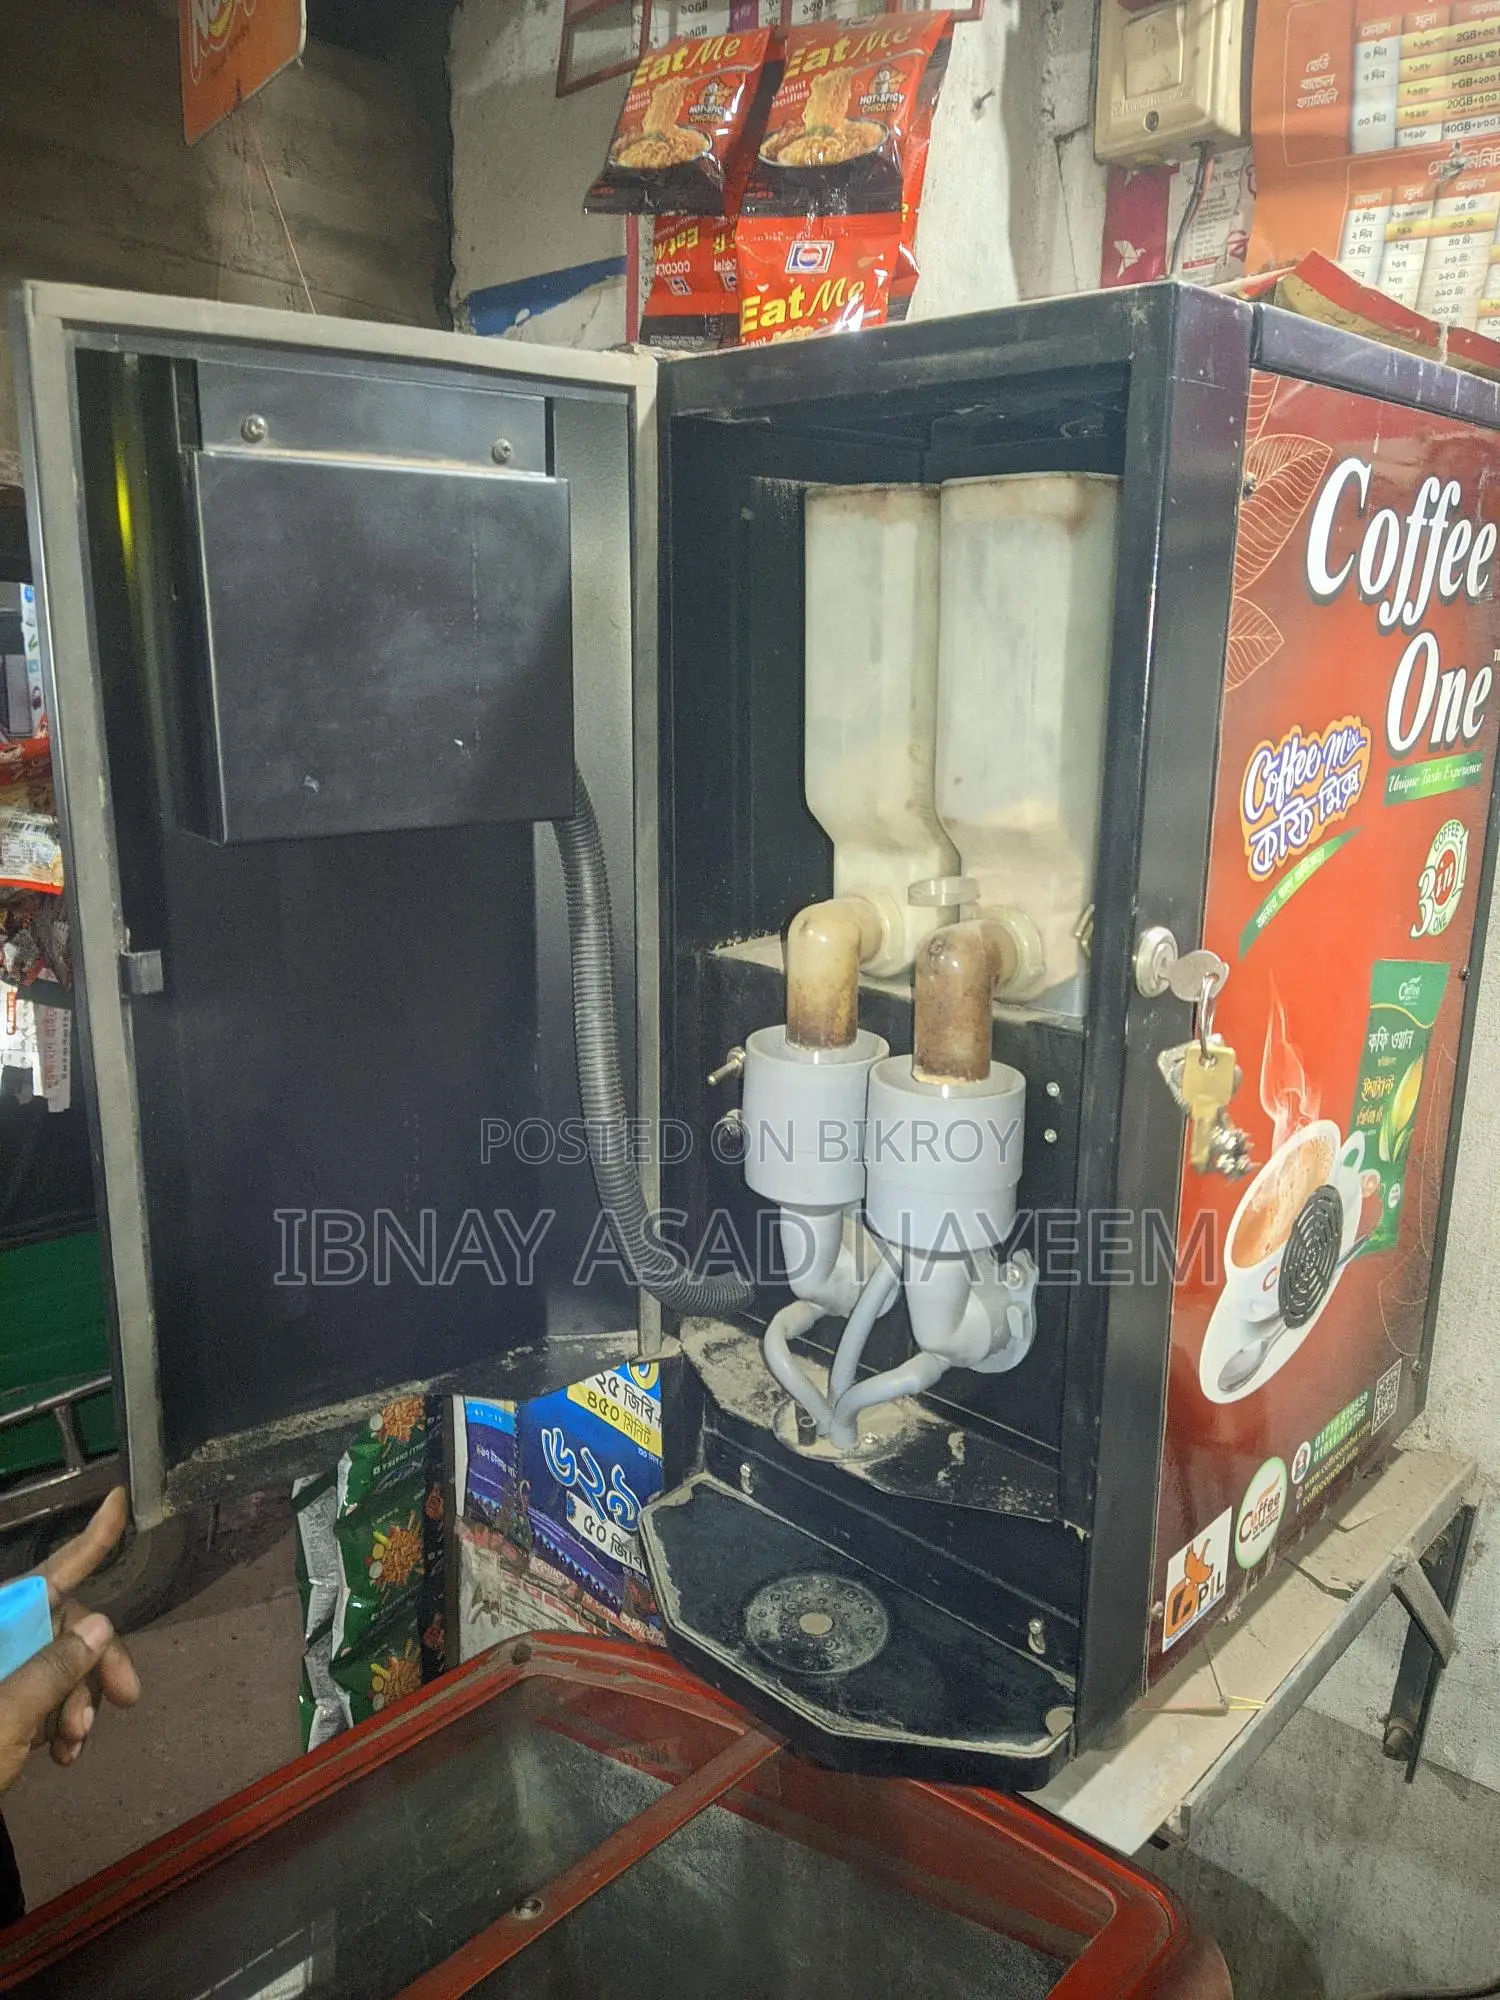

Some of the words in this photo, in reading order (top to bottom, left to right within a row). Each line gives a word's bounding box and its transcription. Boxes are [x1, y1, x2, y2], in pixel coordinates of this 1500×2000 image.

[632, 47, 689, 87] Eat
[685, 35, 741, 70] Me
[785, 37, 851, 78] Eat
[740, 284, 805, 335] Eat
[805, 276, 866, 318] Me
[1306, 458, 1497, 626] Coffee
[1386, 631, 1493, 751] One
[1244, 733, 1320, 822] Coffee
[1388, 772, 1420, 794] Unique
[1442, 761, 1484, 782] Experience
[1250, 796, 1317, 873] কফি
[1435, 863, 1455, 898] in
[1368, 1025, 1390, 1055] কফি
[1391, 1029, 1415, 1050] ওয়ান
[586, 1391, 620, 1421] ৪৫০
[623, 1411, 652, 1446] মিনিট
[623, 1384, 655, 1425] জিবি
[583, 1515, 607, 1543] ৫০
[1238, 1491, 1281, 1543] Coffee
